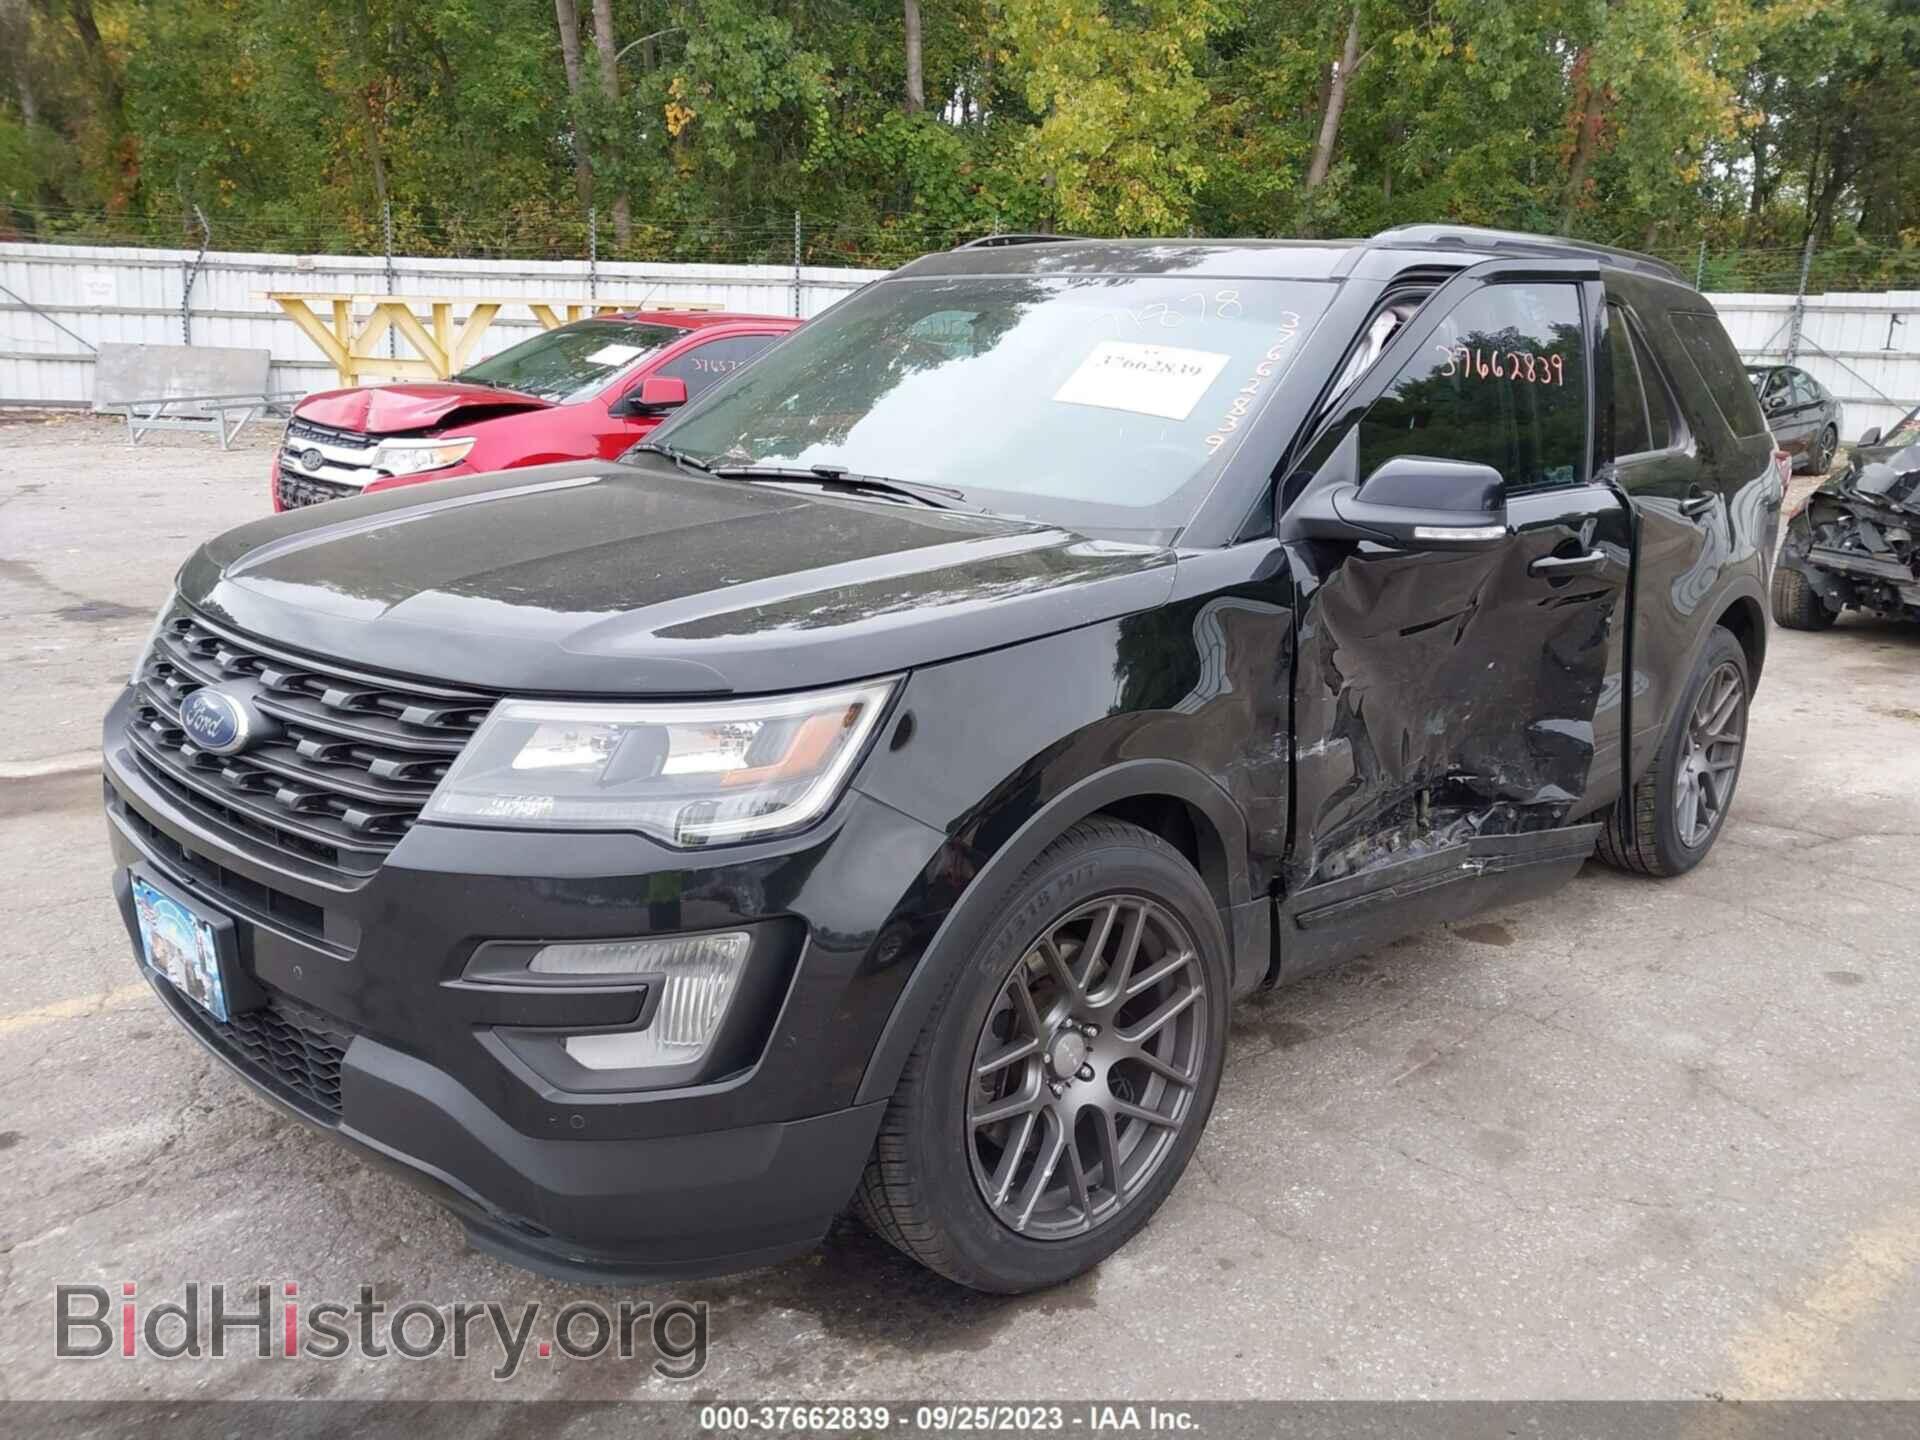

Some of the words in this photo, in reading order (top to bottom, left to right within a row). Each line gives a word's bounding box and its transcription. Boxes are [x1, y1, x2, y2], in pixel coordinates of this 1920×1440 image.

[1205, 310, 1301, 456] 37662839
[1435, 344, 1564, 387] 37662839
[186, 697, 225, 738] Ford
